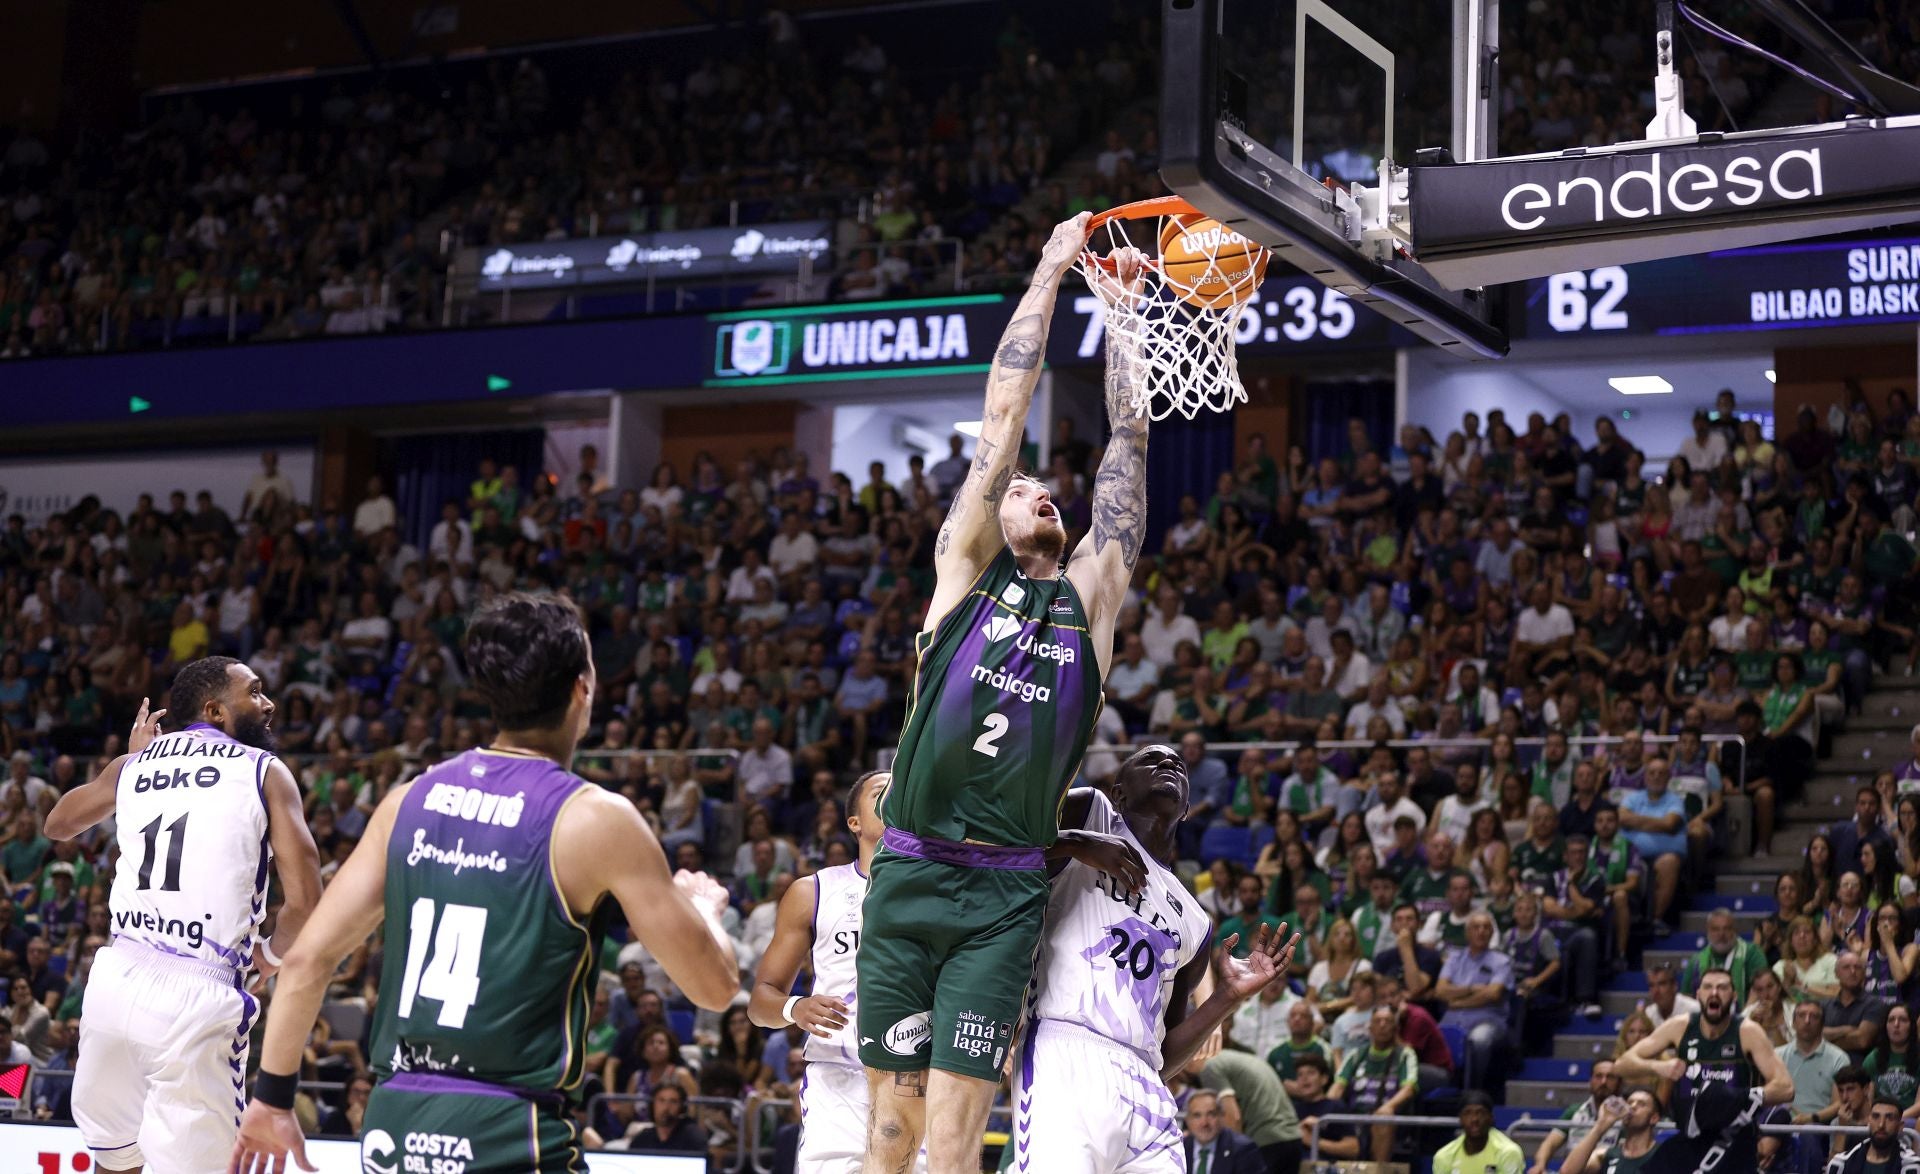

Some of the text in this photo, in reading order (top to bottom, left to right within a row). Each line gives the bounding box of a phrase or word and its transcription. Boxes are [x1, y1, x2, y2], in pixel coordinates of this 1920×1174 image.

[1501, 146, 1824, 231] endesa
[1180, 227, 1254, 255] Wilso
[1548, 265, 1629, 332] 62
[1750, 282, 1920, 322] BILBAO BASK
[803, 314, 968, 366] UNICAJA
[137, 737, 247, 764] HILLIARD
[972, 712, 1009, 758] 2
[134, 767, 191, 794] bbk
[135, 811, 190, 892] 11
[397, 896, 489, 1030] 14
[1108, 927, 1156, 981] 20
[958, 1010, 987, 1022] sabor
[403, 1154, 430, 1174] DEL
[404, 1131, 474, 1161] COSTA
